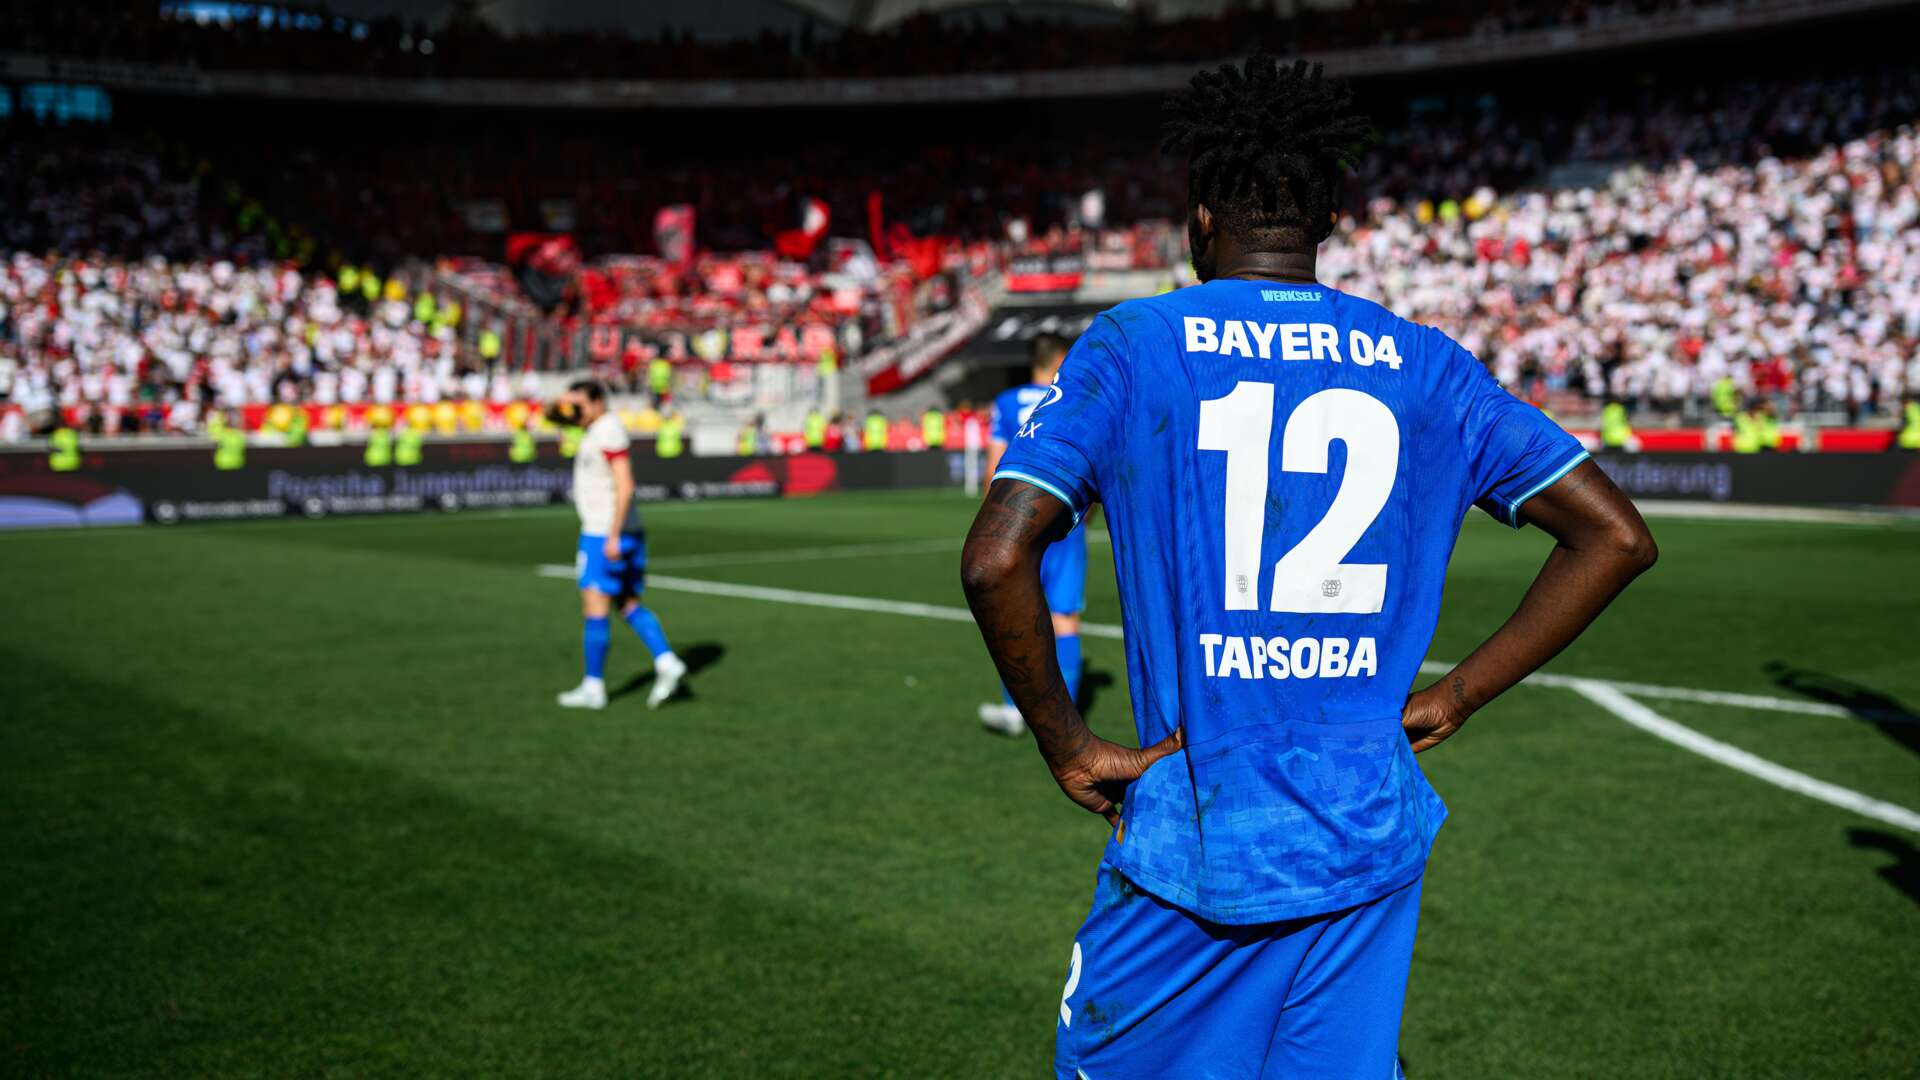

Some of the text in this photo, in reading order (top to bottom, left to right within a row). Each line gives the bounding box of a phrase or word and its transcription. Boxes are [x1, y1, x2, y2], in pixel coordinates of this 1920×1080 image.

[1261, 289, 1323, 302] WERKSELF
[1183, 316, 1403, 370] BAYER 04
[1197, 380, 1401, 614] 12
[1199, 633, 1378, 679] TAPSOBA
